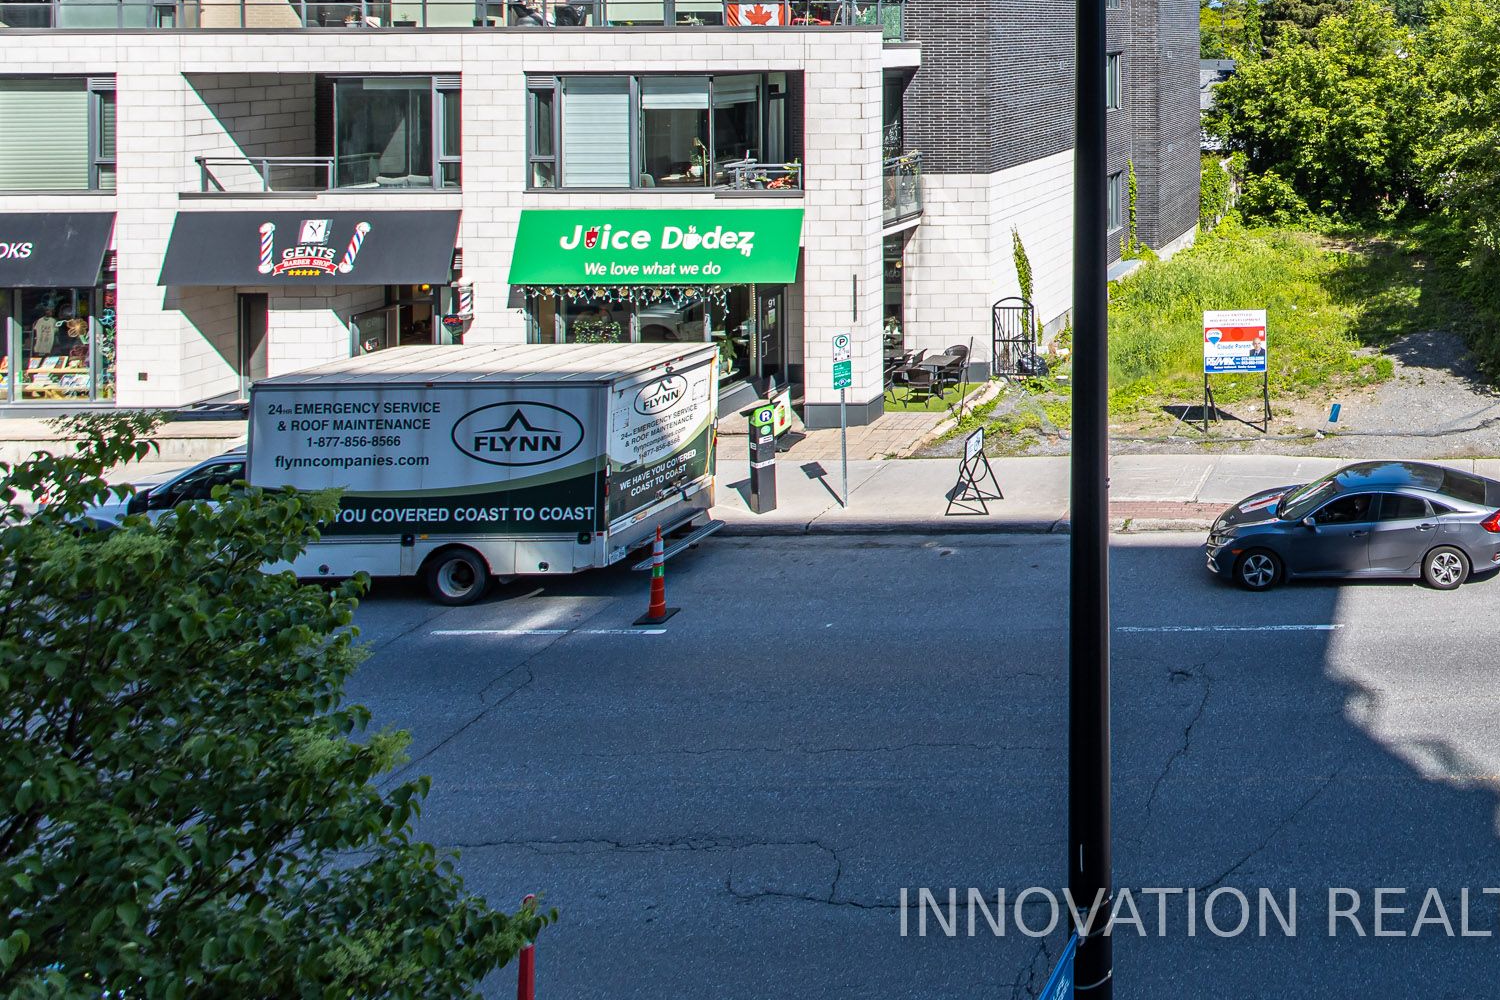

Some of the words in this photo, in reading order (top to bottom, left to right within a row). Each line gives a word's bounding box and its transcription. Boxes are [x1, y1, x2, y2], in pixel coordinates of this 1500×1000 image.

[282, 246, 336, 259] GENTS
[284, 259, 311, 267] BARBER
[312, 259, 331, 267] SHOP
[584, 262, 607, 275] We
[610, 262, 639, 275] love
[642, 262, 676, 275] what
[679, 264, 699, 275] we
[702, 261, 721, 275] do
[294, 402, 380, 415] EMERGENCY
[383, 401, 441, 414] SERVICE
[643, 389, 679, 411] FLYNN
[277, 420, 287, 431] &
[291, 419, 330, 431] ROOF
[332, 418, 431, 431] MAINTENANCE
[633, 414, 672, 436] EMERGENCY
[673, 403, 698, 419] SERVICE
[631, 432, 649, 444] ROOF
[650, 415, 694, 437] MAINTENANCE
[306, 435, 401, 448] 1-877-856-8566
[474, 436, 561, 452] FLYNN
[275, 454, 430, 470] flynncompanies.com
[620, 479, 632, 491] WE
[632, 471, 651, 485] HAVE
[651, 464, 665, 476] YOU
[666, 449, 697, 469] COVERED
[630, 480, 654, 497] COAST
[655, 474, 664, 483] TO
[664, 463, 687, 480] COAST
[333, 508, 366, 523] YOU
[371, 508, 449, 522] COVERED
[453, 507, 508, 522] COAST
[513, 507, 535, 521] TO
[539, 506, 595, 521] COAST
